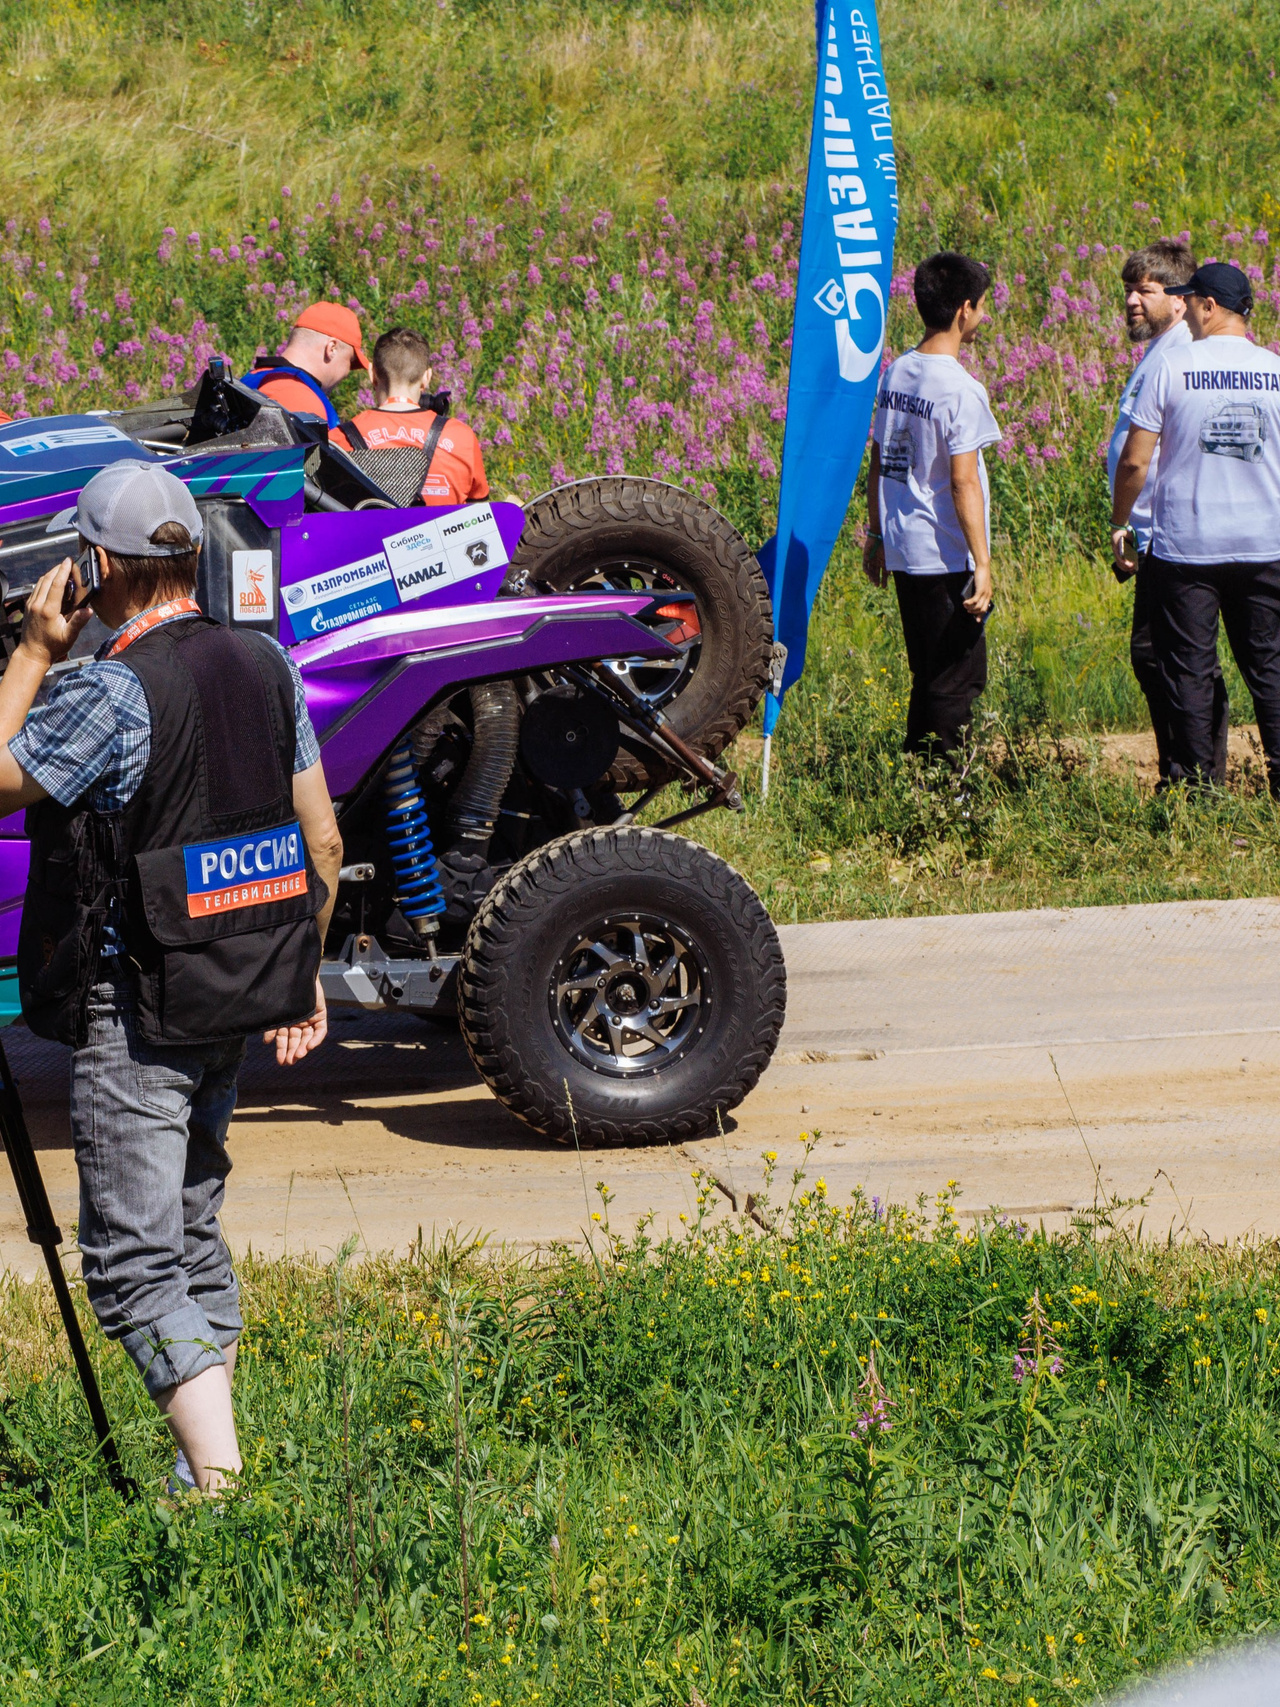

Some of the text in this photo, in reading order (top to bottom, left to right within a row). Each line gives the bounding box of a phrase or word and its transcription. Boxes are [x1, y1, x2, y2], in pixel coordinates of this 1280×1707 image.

[364, 427, 454, 453] ELARS
[442, 512, 493, 537] MONGOLIA
[390, 532, 425, 550] Сибирь
[406, 537, 432, 551] здесь
[310, 560, 388, 595] ГАЗПРОМБАНК
[396, 561, 447, 591] KAMAZ
[239, 606, 268, 614] ПОБЕДА!
[240, 591, 255, 605] 80
[349, 596, 378, 610] СЕТЬ АЗС
[326, 602, 383, 630] ГАЗПРОМНЕФТЬ
[201, 833, 299, 885] РОССИЯ
[204, 877, 300, 909] ТЕЛЕВИДЕНИЕ
